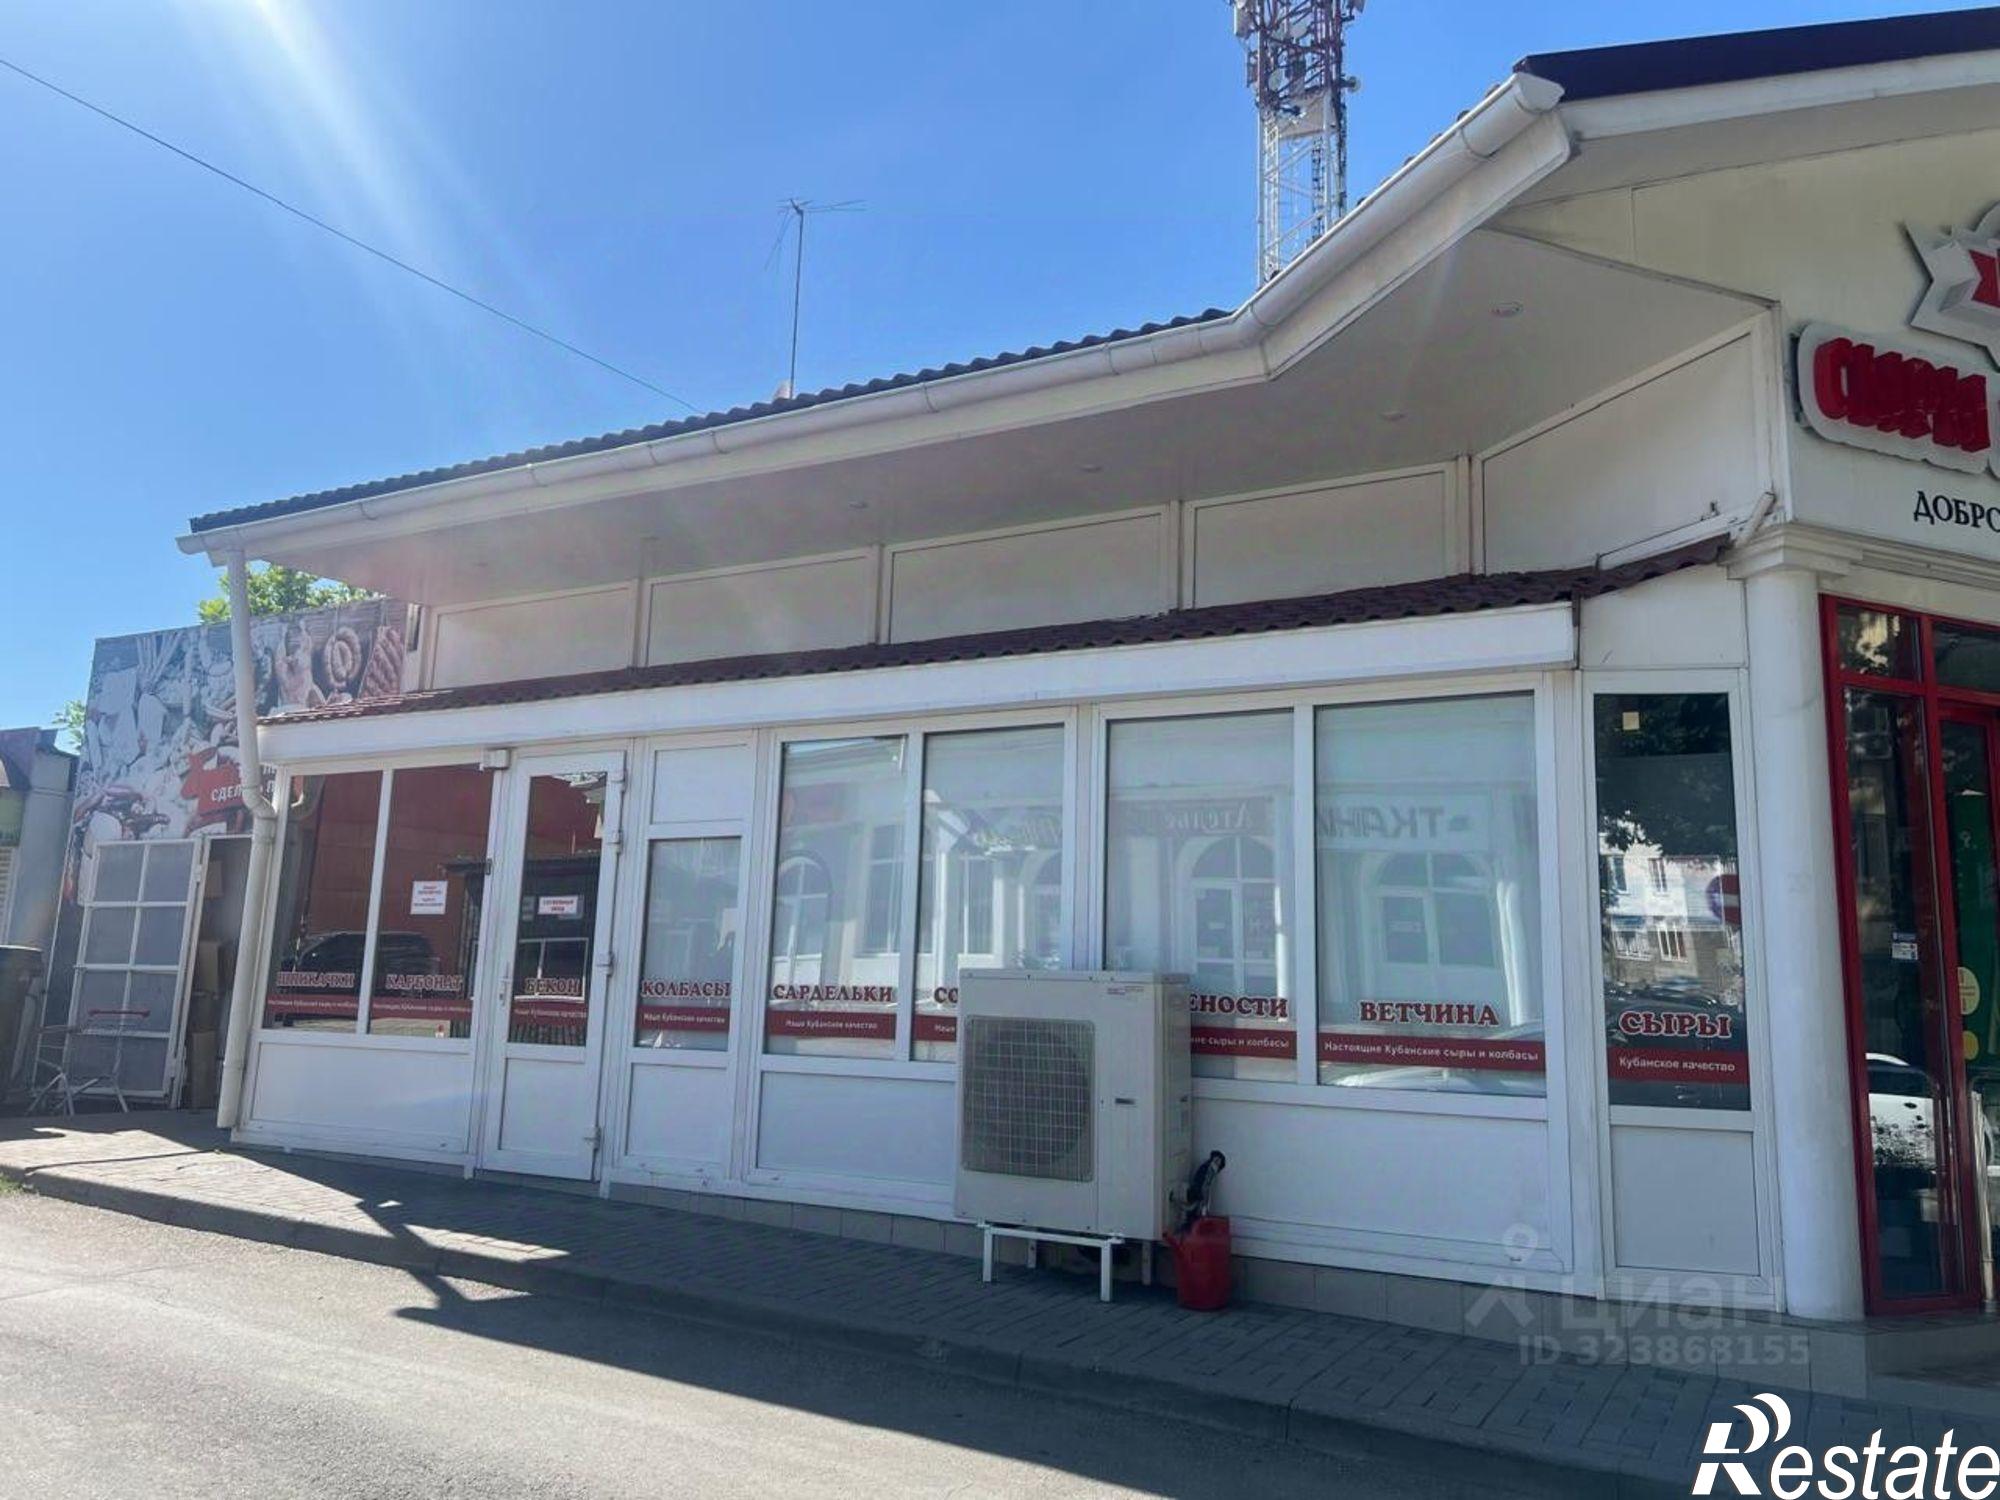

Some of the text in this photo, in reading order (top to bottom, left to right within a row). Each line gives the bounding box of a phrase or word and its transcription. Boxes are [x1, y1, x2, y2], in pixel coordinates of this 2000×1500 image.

[525, 977, 581, 995] БЕКОН
[641, 980, 732, 998] КОЛБАСЫ
[773, 984, 894, 1002] САРДЕЛЬКИ
[1360, 1001, 1499, 1026] ВЕТЧИНА
[1619, 1010, 1733, 1039] СЫРЫ
[1619, 1057, 1736, 1073] Кубанское качество
